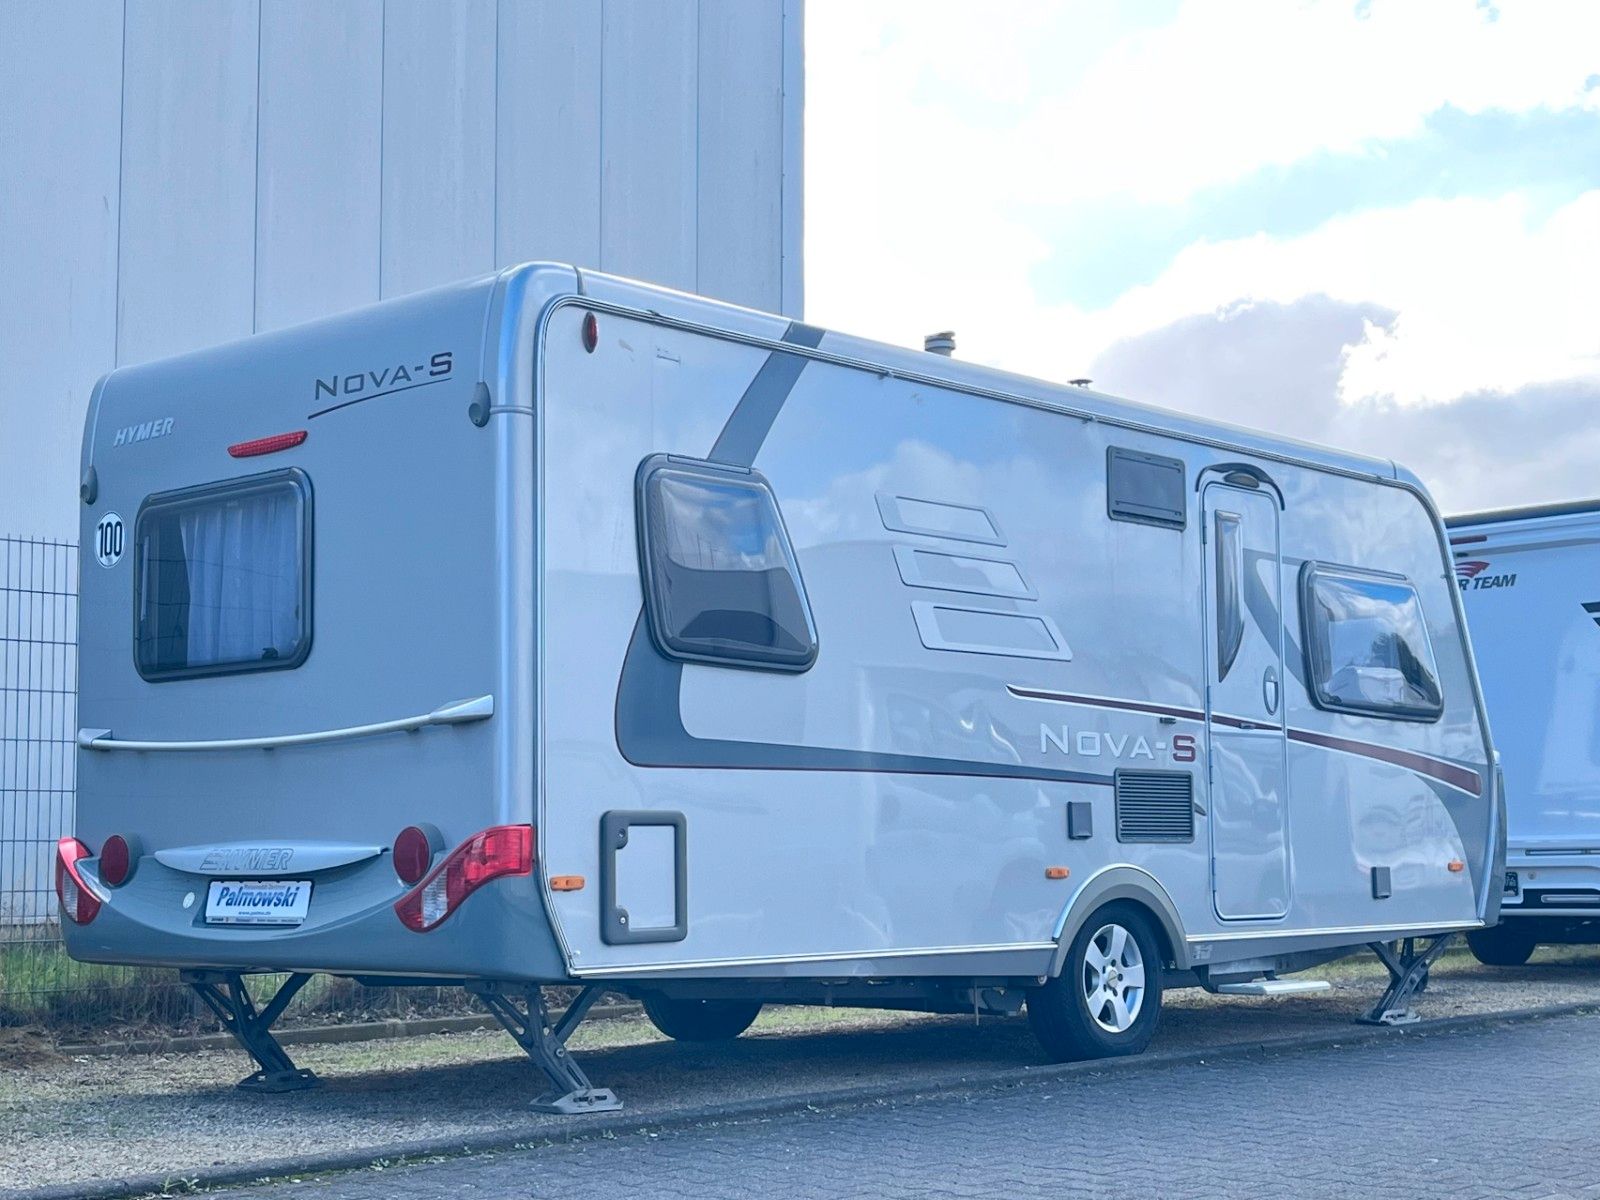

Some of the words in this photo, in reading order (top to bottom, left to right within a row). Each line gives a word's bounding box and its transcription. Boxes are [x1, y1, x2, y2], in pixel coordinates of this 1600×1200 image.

[113, 416, 176, 448] HYMER
[98, 521, 123, 558] 100
[1458, 578, 1470, 591] R
[1473, 573, 1517, 590] TEAM
[216, 886, 301, 908] Palmowski
